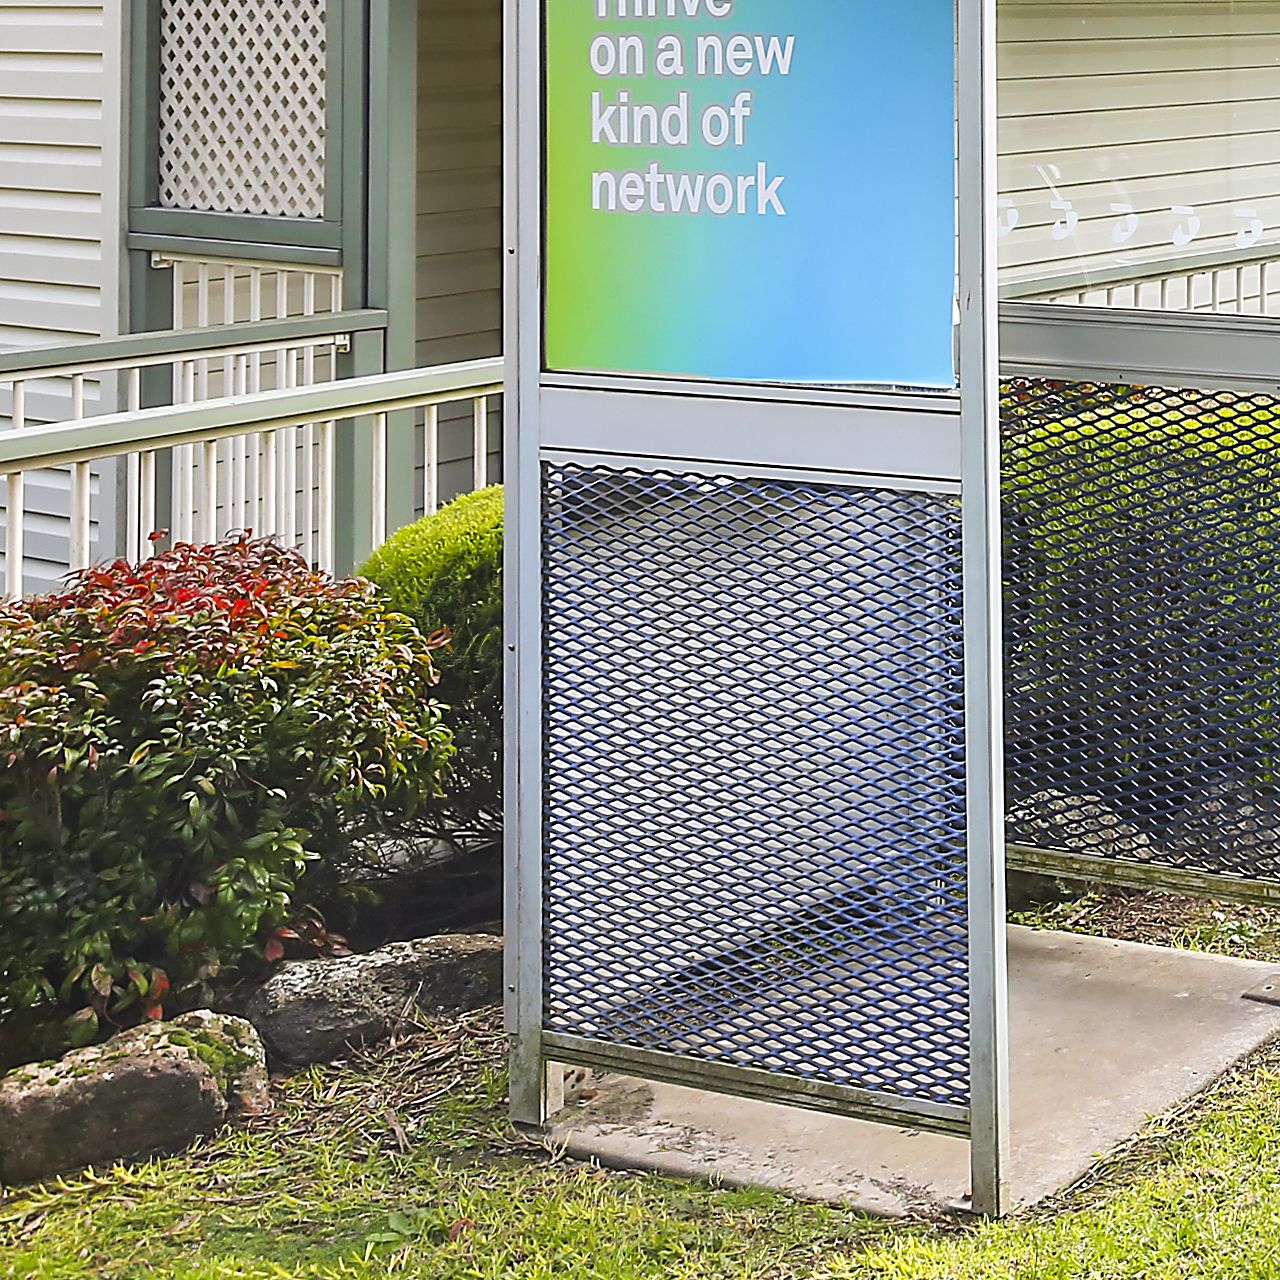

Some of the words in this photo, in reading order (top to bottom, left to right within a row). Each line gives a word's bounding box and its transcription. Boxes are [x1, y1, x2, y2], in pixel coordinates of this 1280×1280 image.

[589, 34, 644, 76] on
[655, 34, 684, 76] a
[696, 34, 796, 76] new
[591, 90, 689, 145] kind
[701, 91, 751, 146] of
[591, 161, 787, 216] network
